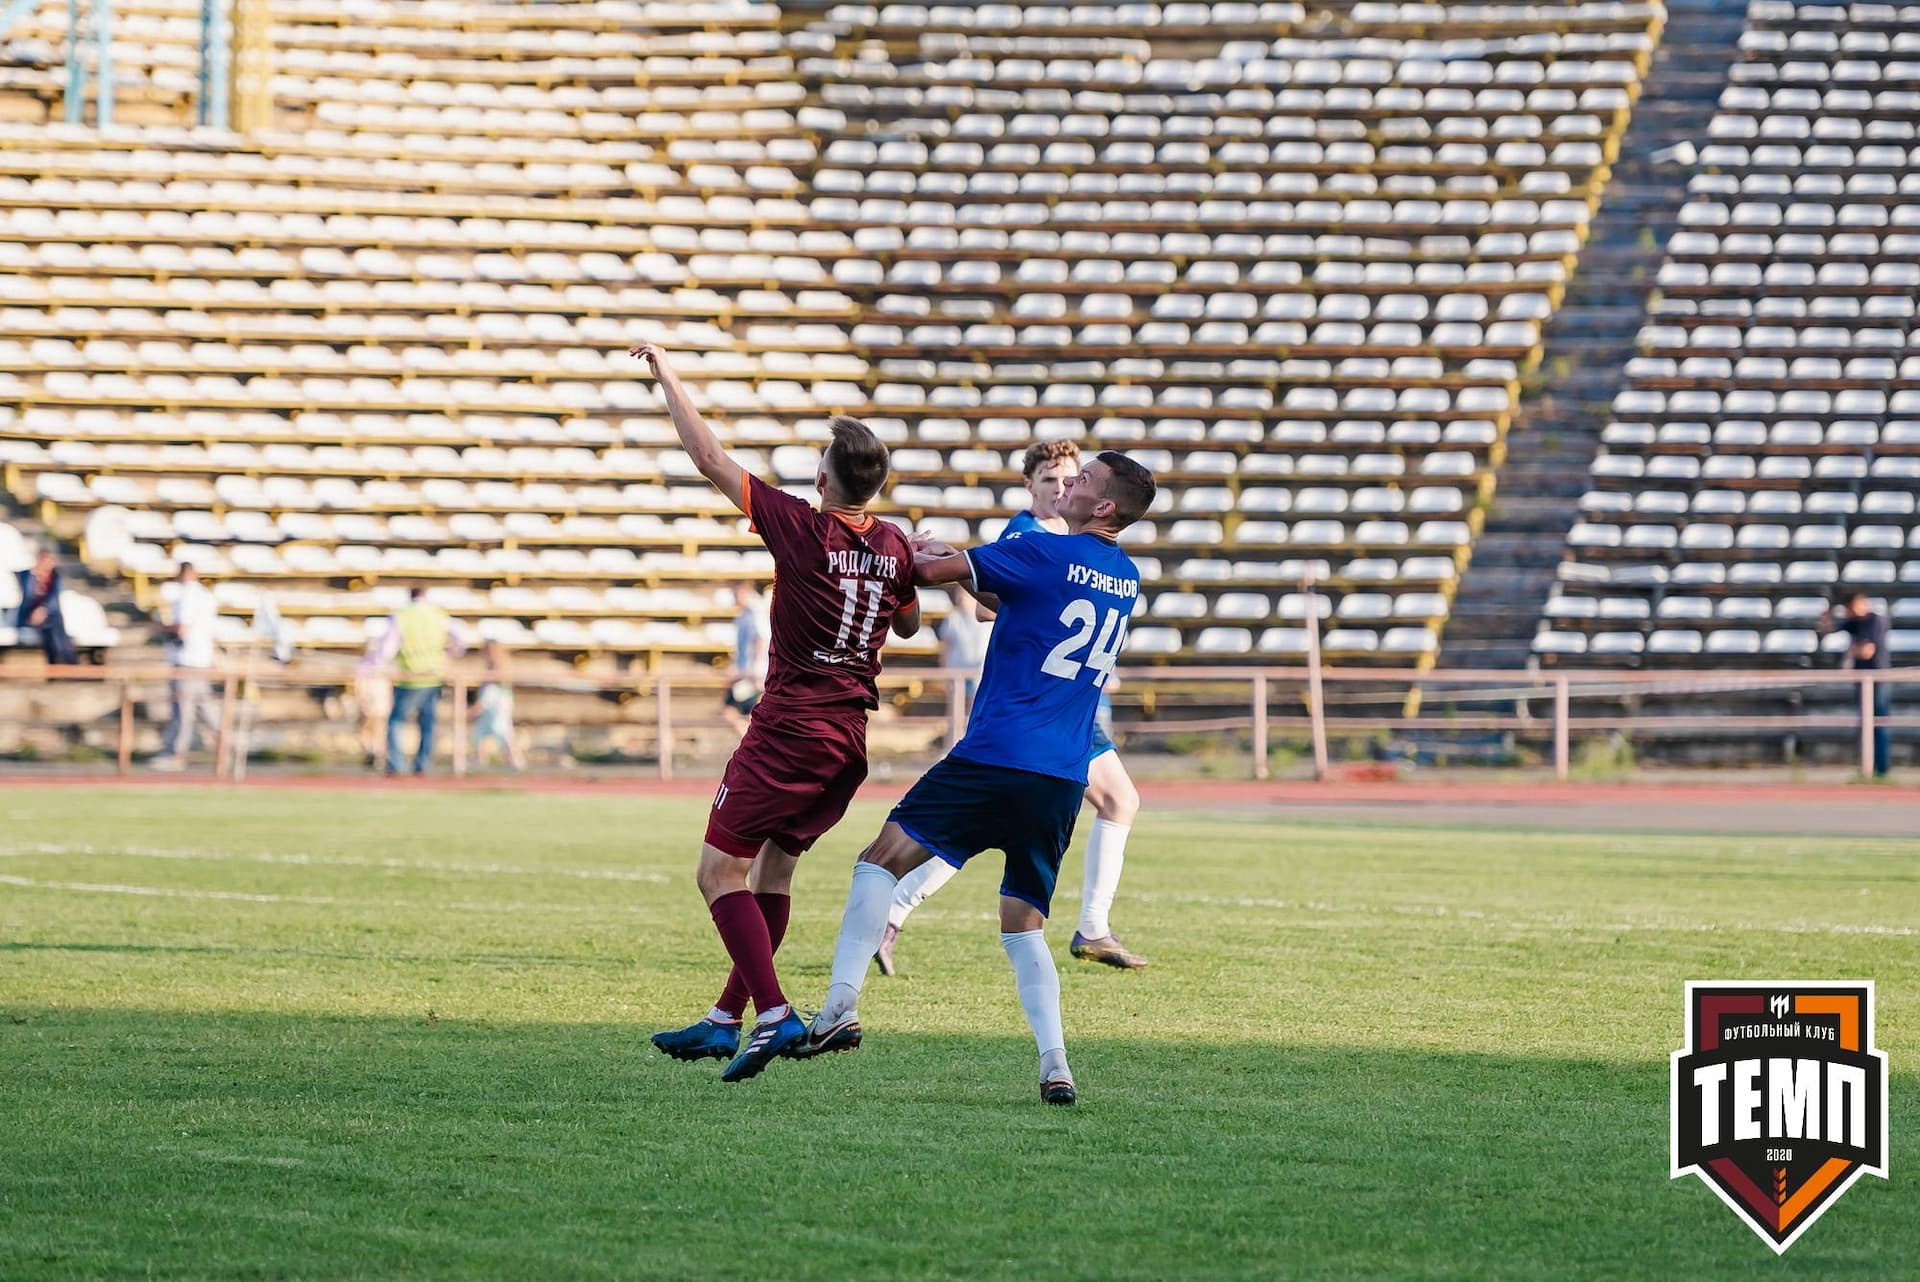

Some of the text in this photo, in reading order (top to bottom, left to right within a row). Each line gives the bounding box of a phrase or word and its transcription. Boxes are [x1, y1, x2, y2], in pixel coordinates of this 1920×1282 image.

[828, 550, 897, 579] РОДИЧЕВ
[1066, 563, 1138, 599] КУЗНЕЦОВ
[834, 578, 884, 649] 11
[1040, 599, 1129, 688] 24
